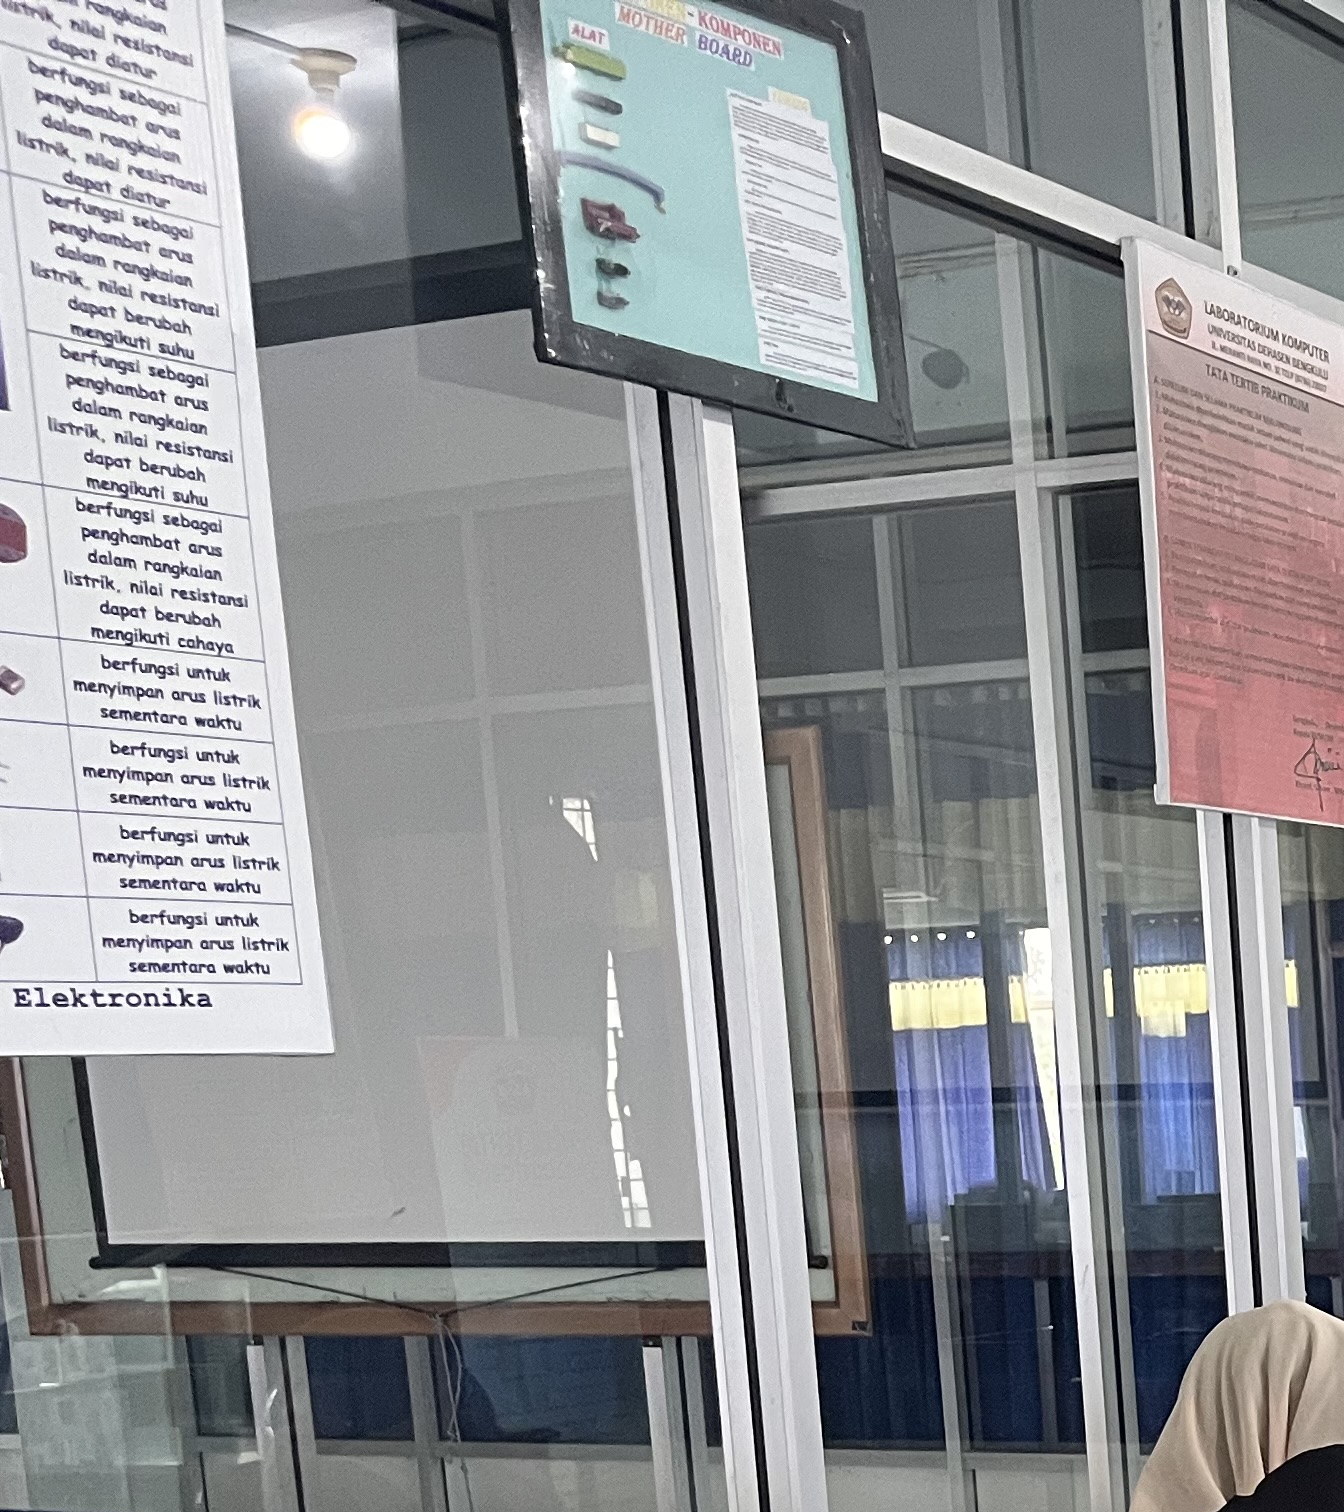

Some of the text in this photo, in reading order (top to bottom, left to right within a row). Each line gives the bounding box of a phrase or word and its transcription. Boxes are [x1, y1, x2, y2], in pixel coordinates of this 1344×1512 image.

[571, 23, 605, 45] ALAT
[618, 6, 686, 44] MOTHER
[698, 33, 753, 67] BOARD
[698, 9, 782, 57] KOMPONEN
[47, 34, 157, 79] dapat diatur
[27, 57, 181, 116] berfungsi sebagai
[34, 88, 181, 141] penghambat arus
[41, 113, 181, 164] dalam rangkaian
[62, 170, 170, 209] dapat diatur
[127, 164, 208, 195] resistansi
[42, 189, 194, 241] berfungsi sebagai
[48, 218, 194, 264] penghambat arus
[55, 243, 193, 288] dalam rangkaian
[98, 279, 133, 299] nilai
[140, 290, 219, 318] resistansi
[67, 296, 192, 335] dapat berubah
[70, 324, 195, 360] mengikuti suhu
[1204, 300, 1330, 364] LABORATORIUM KOMPUTER
[1207, 323, 1256, 351] UNIVERSITAS
[59, 343, 210, 389] berfungsi sebagai
[1205, 363, 1229, 383] TATA
[65, 373, 209, 411] penghambat arus
[72, 397, 208, 435] dalam rangkaian
[114, 431, 148, 448] nilai
[156, 438, 234, 464] resistansi
[83, 449, 207, 483] dapat berubah
[86, 476, 208, 507] mengikuti suhu
[75, 496, 222, 535] berfungsi sebagai
[81, 526, 223, 557] penghambat arus
[88, 549, 223, 582] dalam rangkaian
[130, 580, 163, 597] nilai
[171, 586, 248, 608] resistansi
[99, 600, 222, 629] dapat berubah
[91, 626, 234, 657] mengikuti cahaya
[100, 654, 231, 683] berfungsi untuk
[73, 679, 261, 709] menyimpan arus listrik
[100, 707, 242, 731] sementara waktu
[110, 740, 240, 765] berfungsi untuk
[83, 766, 271, 791] menyimpan arus listrik
[110, 792, 251, 813] sementara waktu
[119, 825, 250, 847] berfungsi untuk
[92, 851, 280, 872] menyimpan arus listrik
[119, 877, 261, 894] sementara waktu
[129, 909, 259, 929] berfungsi untuk
[102, 935, 290, 953] menyimpan arus listrik
[129, 960, 270, 975] sementara waktu
[13, 987, 213, 1008] Elektronika
